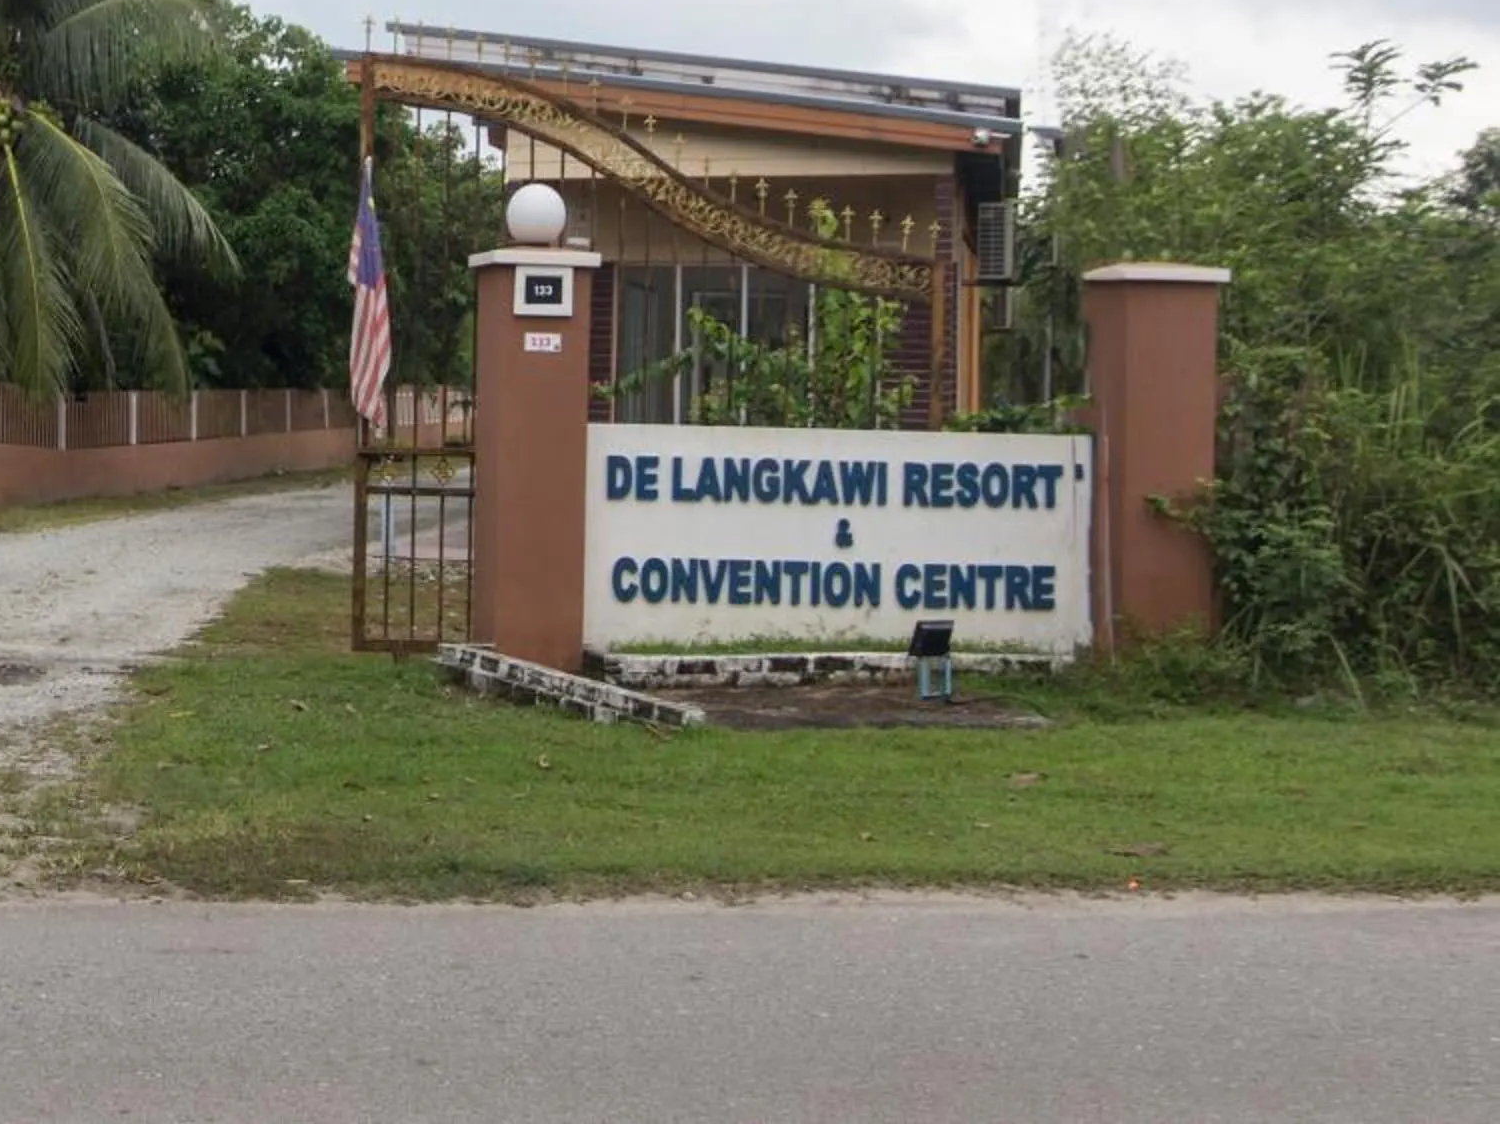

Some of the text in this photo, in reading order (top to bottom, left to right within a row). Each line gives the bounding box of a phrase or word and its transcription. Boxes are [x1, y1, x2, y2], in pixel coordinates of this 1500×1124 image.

[606, 455, 1063, 510] DE LANGKAWI RESORT
[835, 518, 853, 549] &
[611, 557, 1056, 610] CONVENTION CENTRE
